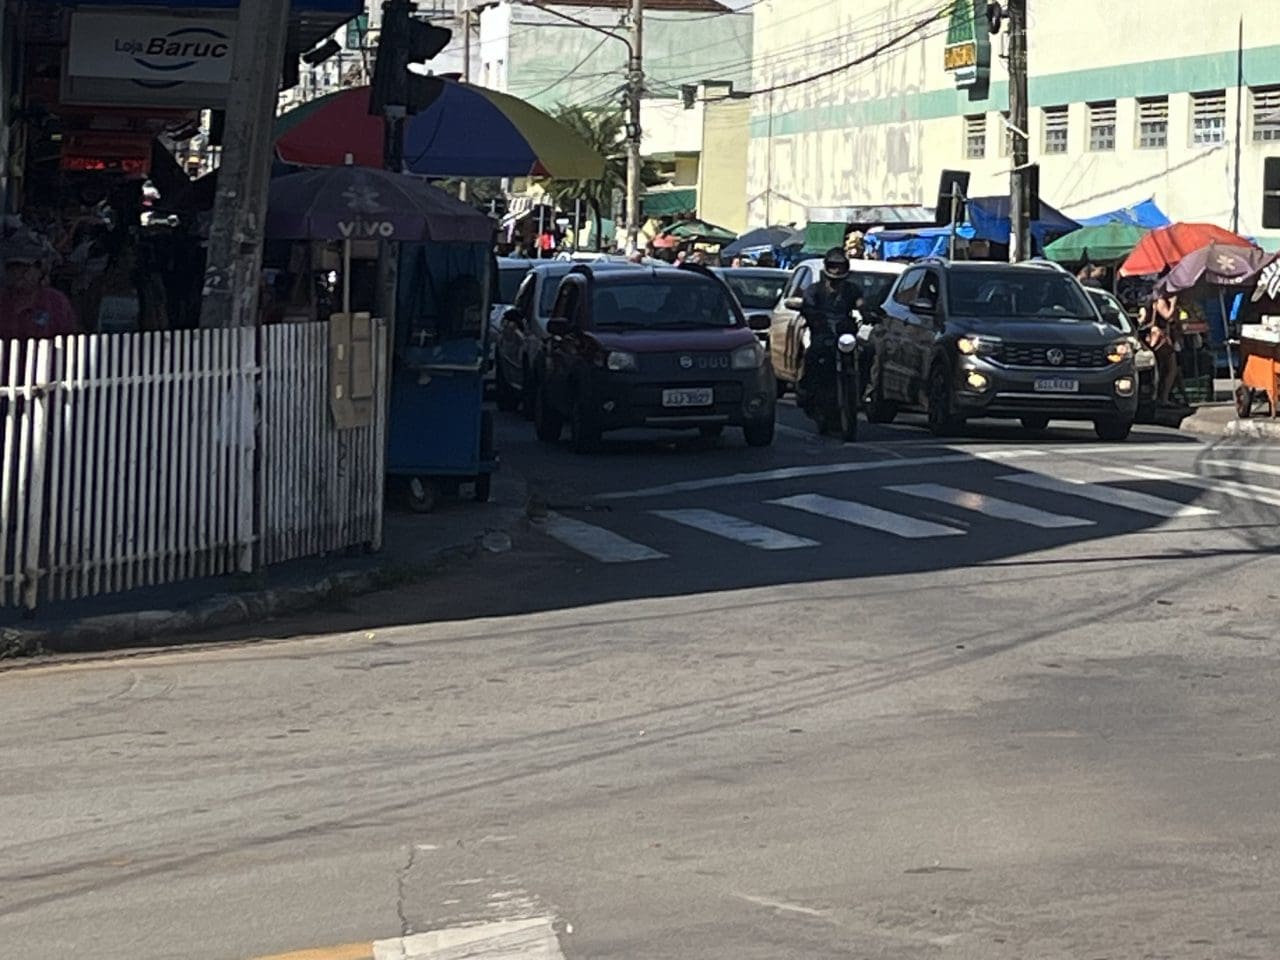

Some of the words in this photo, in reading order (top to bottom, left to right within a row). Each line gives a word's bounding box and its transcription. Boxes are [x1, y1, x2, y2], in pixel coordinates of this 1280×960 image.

[115, 39, 143, 54] Loja
[146, 38, 228, 58] Baruc
[337, 215, 395, 237] vivo
